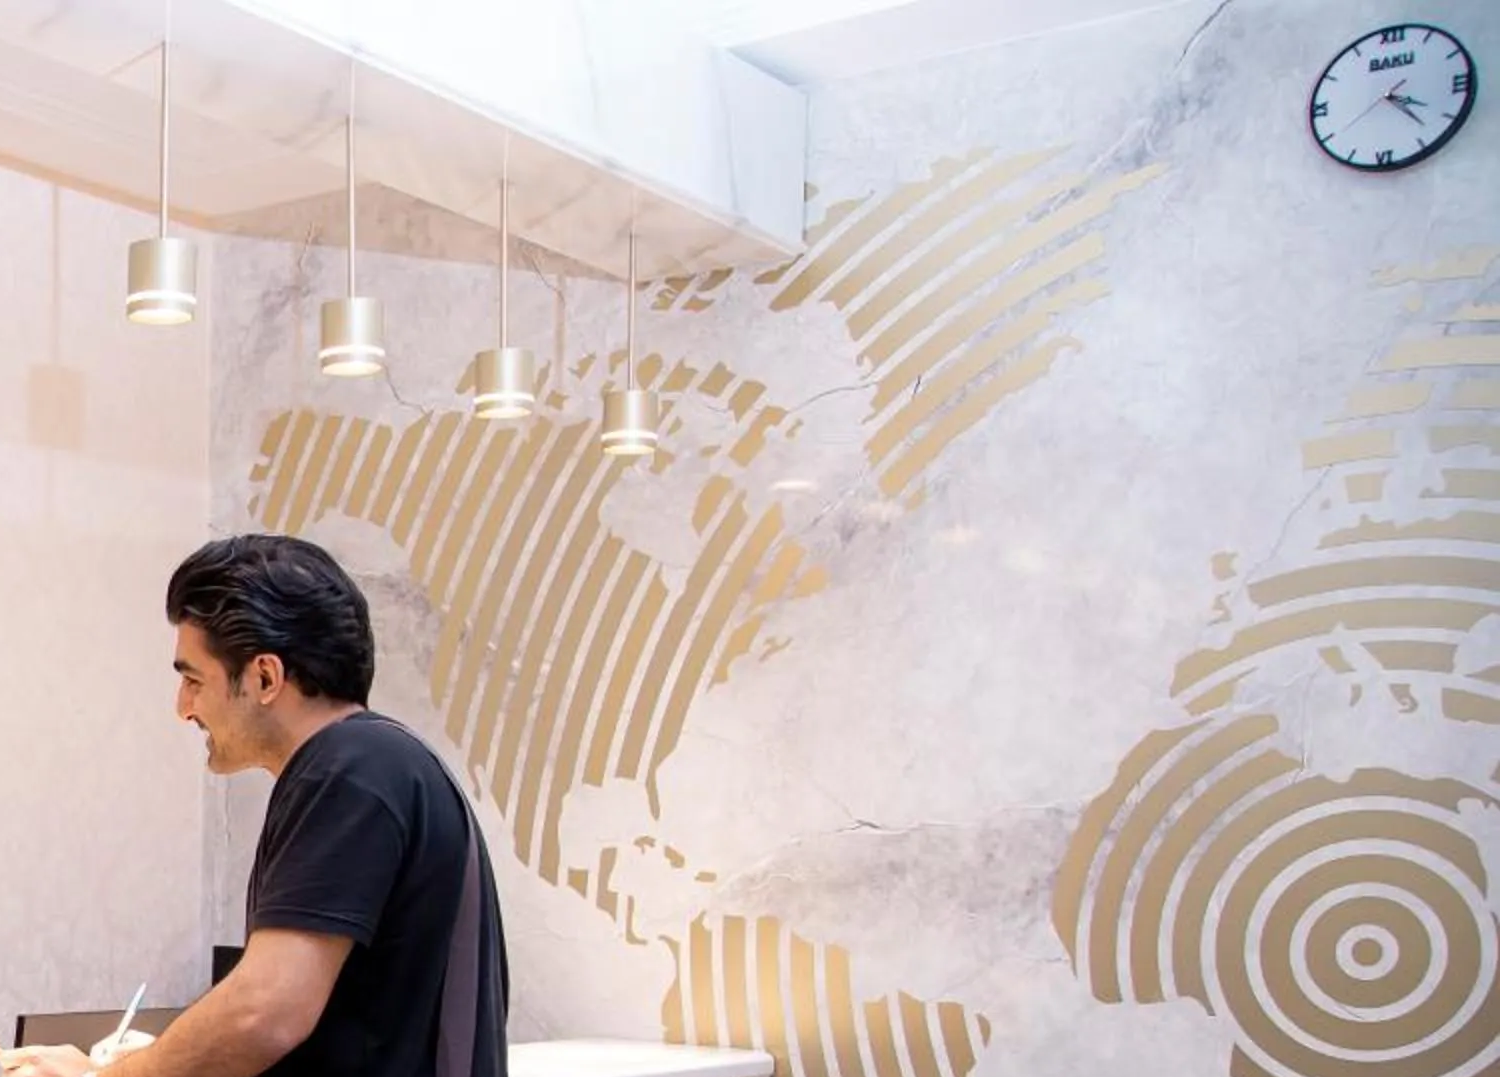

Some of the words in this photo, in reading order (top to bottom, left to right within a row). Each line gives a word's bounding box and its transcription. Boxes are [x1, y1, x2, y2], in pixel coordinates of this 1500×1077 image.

[1380, 28, 1405, 44] XII
[1369, 52, 1414, 72] BAKU
[1452, 73, 1469, 94] III
[1375, 149, 1394, 164] VI
